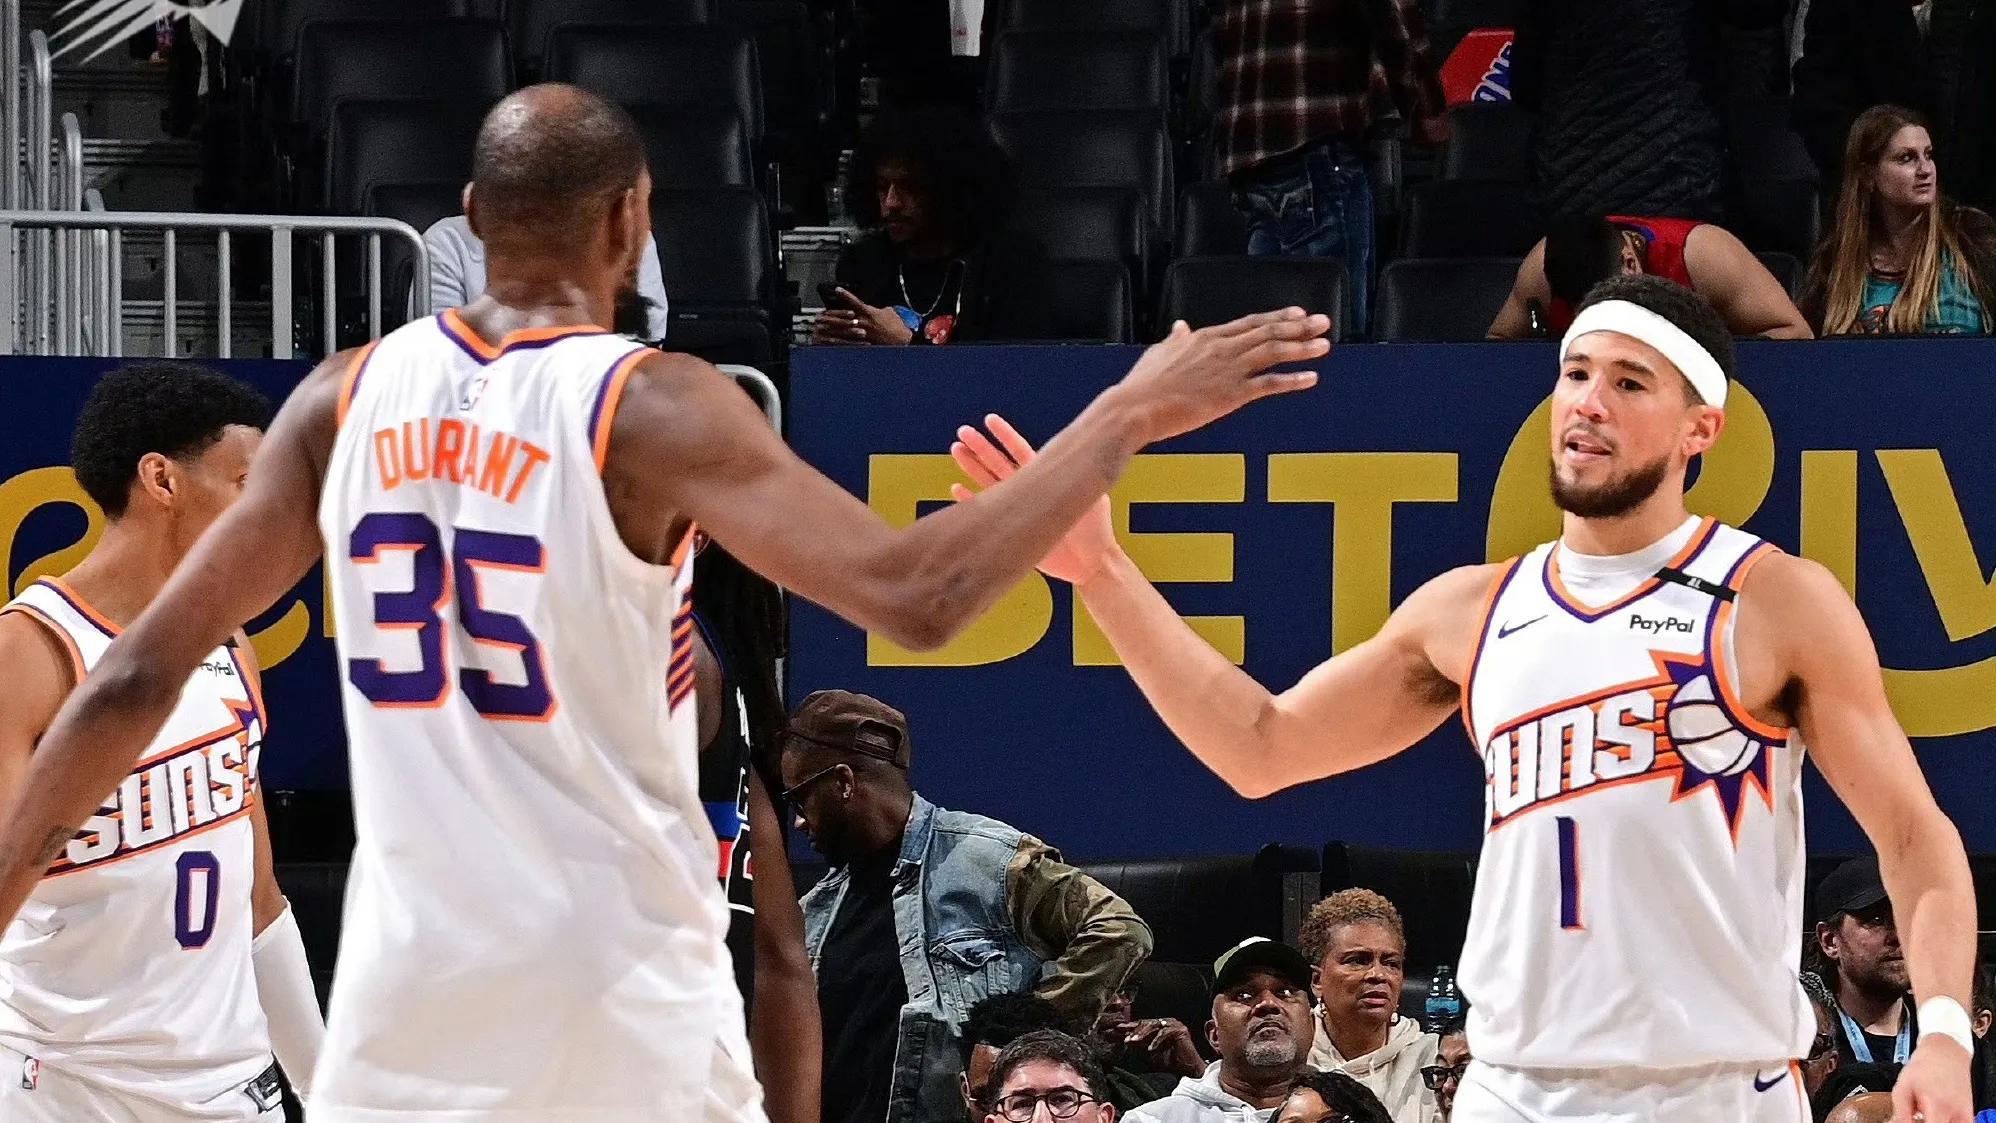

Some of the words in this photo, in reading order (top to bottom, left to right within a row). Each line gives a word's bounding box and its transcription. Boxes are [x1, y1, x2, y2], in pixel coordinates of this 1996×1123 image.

[374, 417, 551, 504] DURANT
[348, 512, 559, 723] 35
[1629, 613, 1695, 635] PayPal
[1485, 689, 1656, 824] UNS
[174, 850, 221, 950] 0
[1555, 816, 1585, 930] 1
